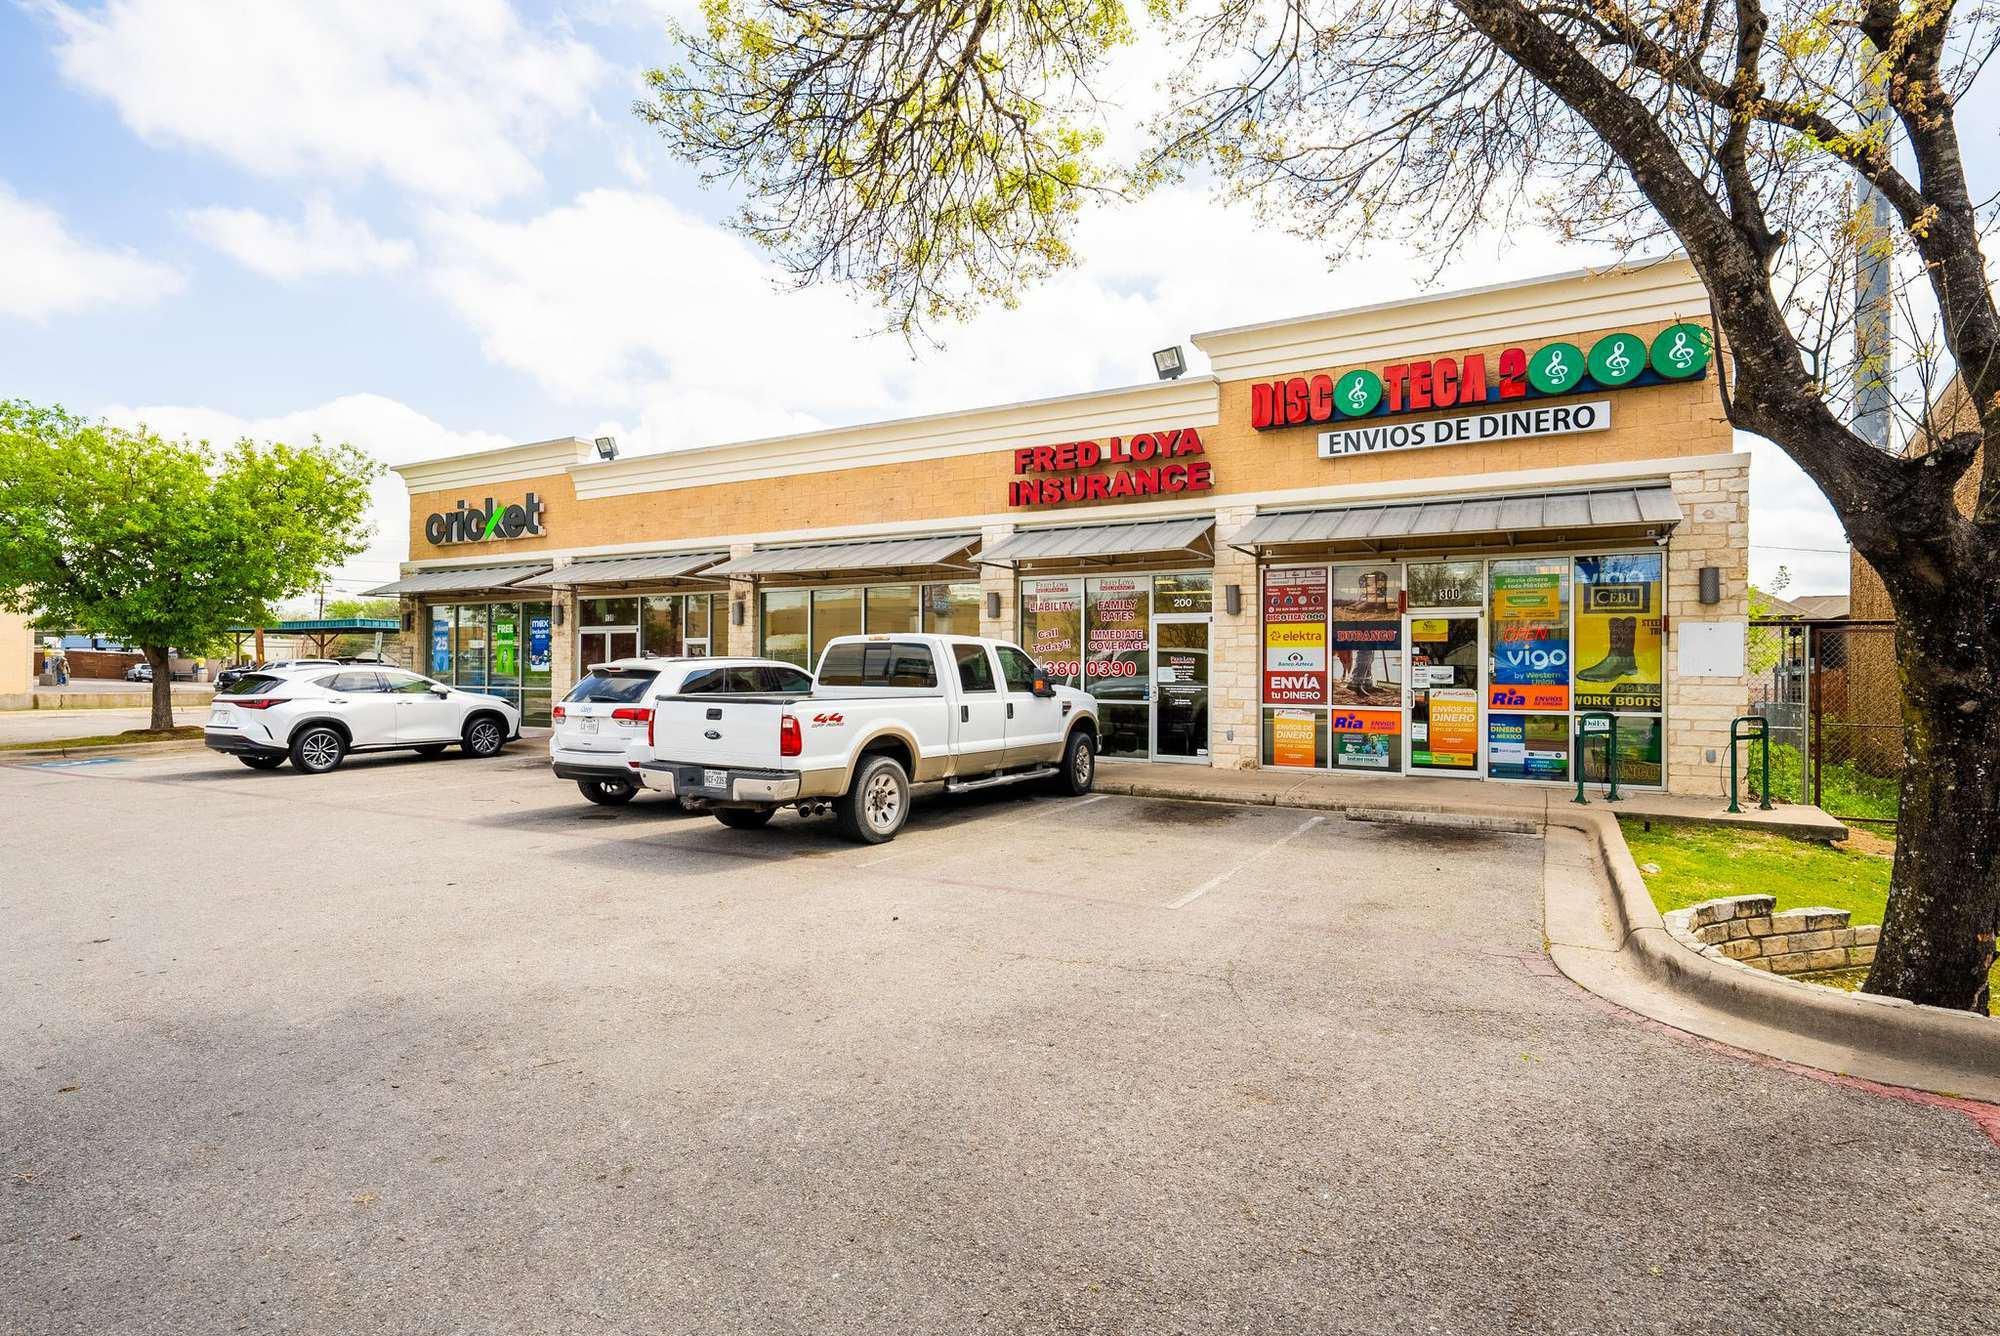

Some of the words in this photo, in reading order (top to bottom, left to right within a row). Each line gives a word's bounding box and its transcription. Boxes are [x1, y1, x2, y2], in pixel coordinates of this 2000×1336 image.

[1328, 421, 1426, 455] ENVIOS
[1435, 417, 1470, 443] DE
[1479, 405, 1596, 439] DINERO
[1014, 440, 1101, 474] FRED
[1110, 428, 1205, 463] LOYA
[1009, 462, 1212, 506] INSURANCE
[425, 492, 546, 545] cricket
[1440, 589, 1460, 599] 300
[1596, 591, 1635, 604] CEBU
[1029, 601, 1075, 613] LIABILITY
[1098, 599, 1137, 611] FAMILY
[1174, 597, 1193, 607] 200
[1101, 610, 1136, 622] RATES
[497, 624, 514, 634] FREE
[1037, 628, 1059, 640] Call
[1503, 627, 1548, 641] OPEN
[1091, 630, 1143, 641] IMMEDIATE
[1283, 631, 1322, 641] elektra
[1337, 630, 1396, 642] DURANGO
[1032, 639, 1071, 653] Today!!
[1088, 640, 1148, 651] COVERAGE
[1507, 644, 1567, 670] vigo
[1045, 660, 1080, 678] 380
[1086, 660, 1138, 678] 0390
[1270, 673, 1320, 689] ENVÍA
[1514, 672, 1524, 680] by
[1526, 671, 1561, 679] Western
[1271, 691, 1280, 699] tu
[1282, 691, 1320, 700] DINERO
[1492, 688, 1526, 706] Ria
[1575, 695, 1612, 706] WORK
[1615, 696, 1661, 707] BOOTS
[1462, 705, 1475, 713] DE
[1334, 713, 1364, 730] Ria
[1432, 713, 1475, 722] DINERO
[1276, 731, 1313, 740] DINERO
